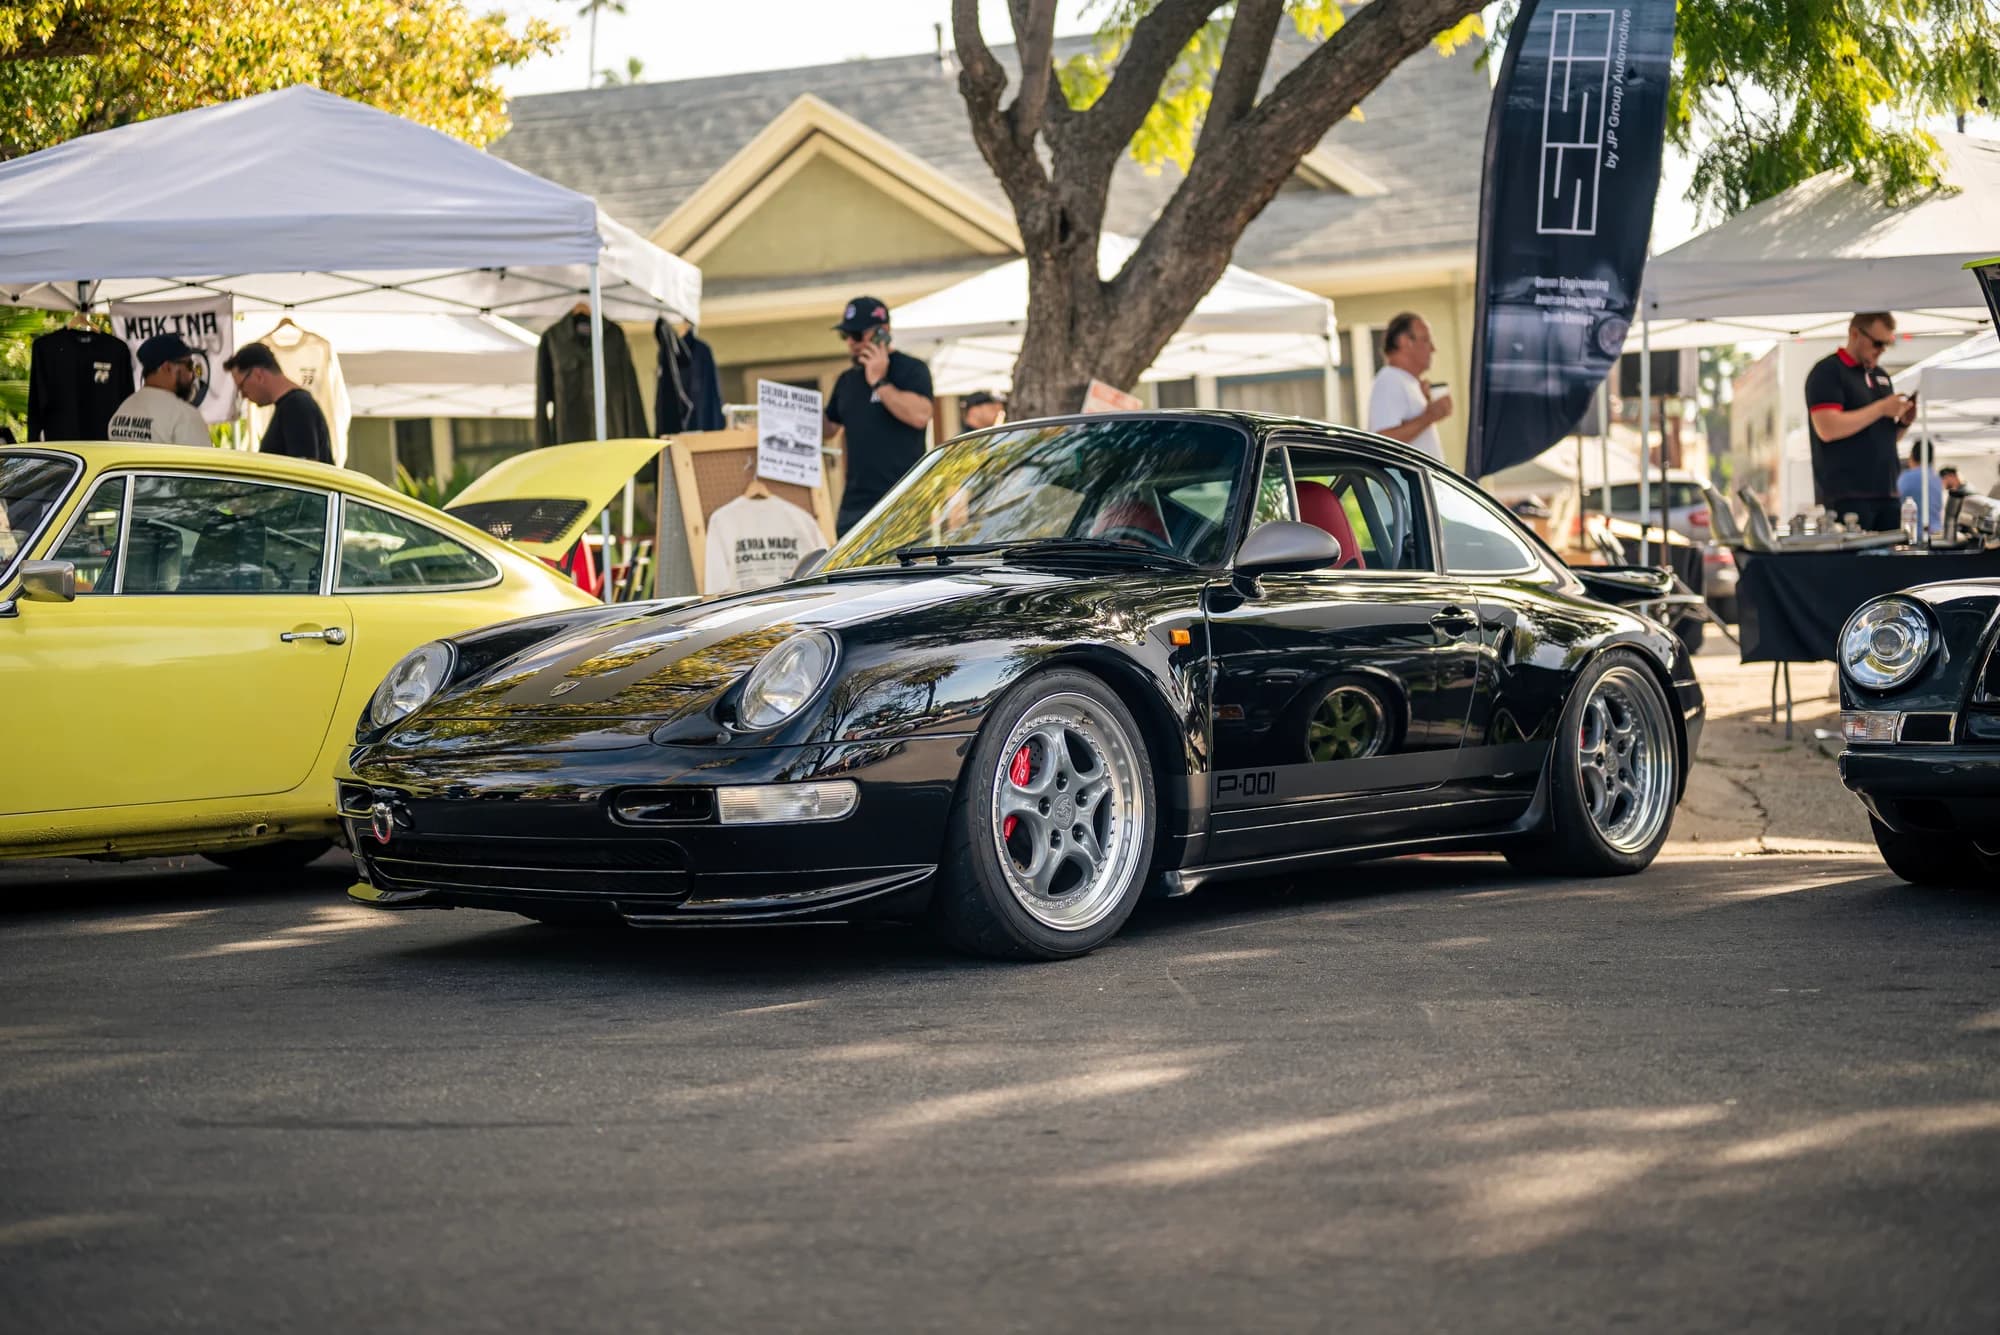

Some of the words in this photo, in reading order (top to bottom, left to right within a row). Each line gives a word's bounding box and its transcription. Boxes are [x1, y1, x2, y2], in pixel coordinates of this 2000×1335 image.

[1612, 8, 1632, 83] Automotive
[1608, 85, 1625, 128] Group
[1606, 130, 1619, 149] JP
[1604, 151, 1620, 169] by
[124, 310, 217, 339] MAKINA
